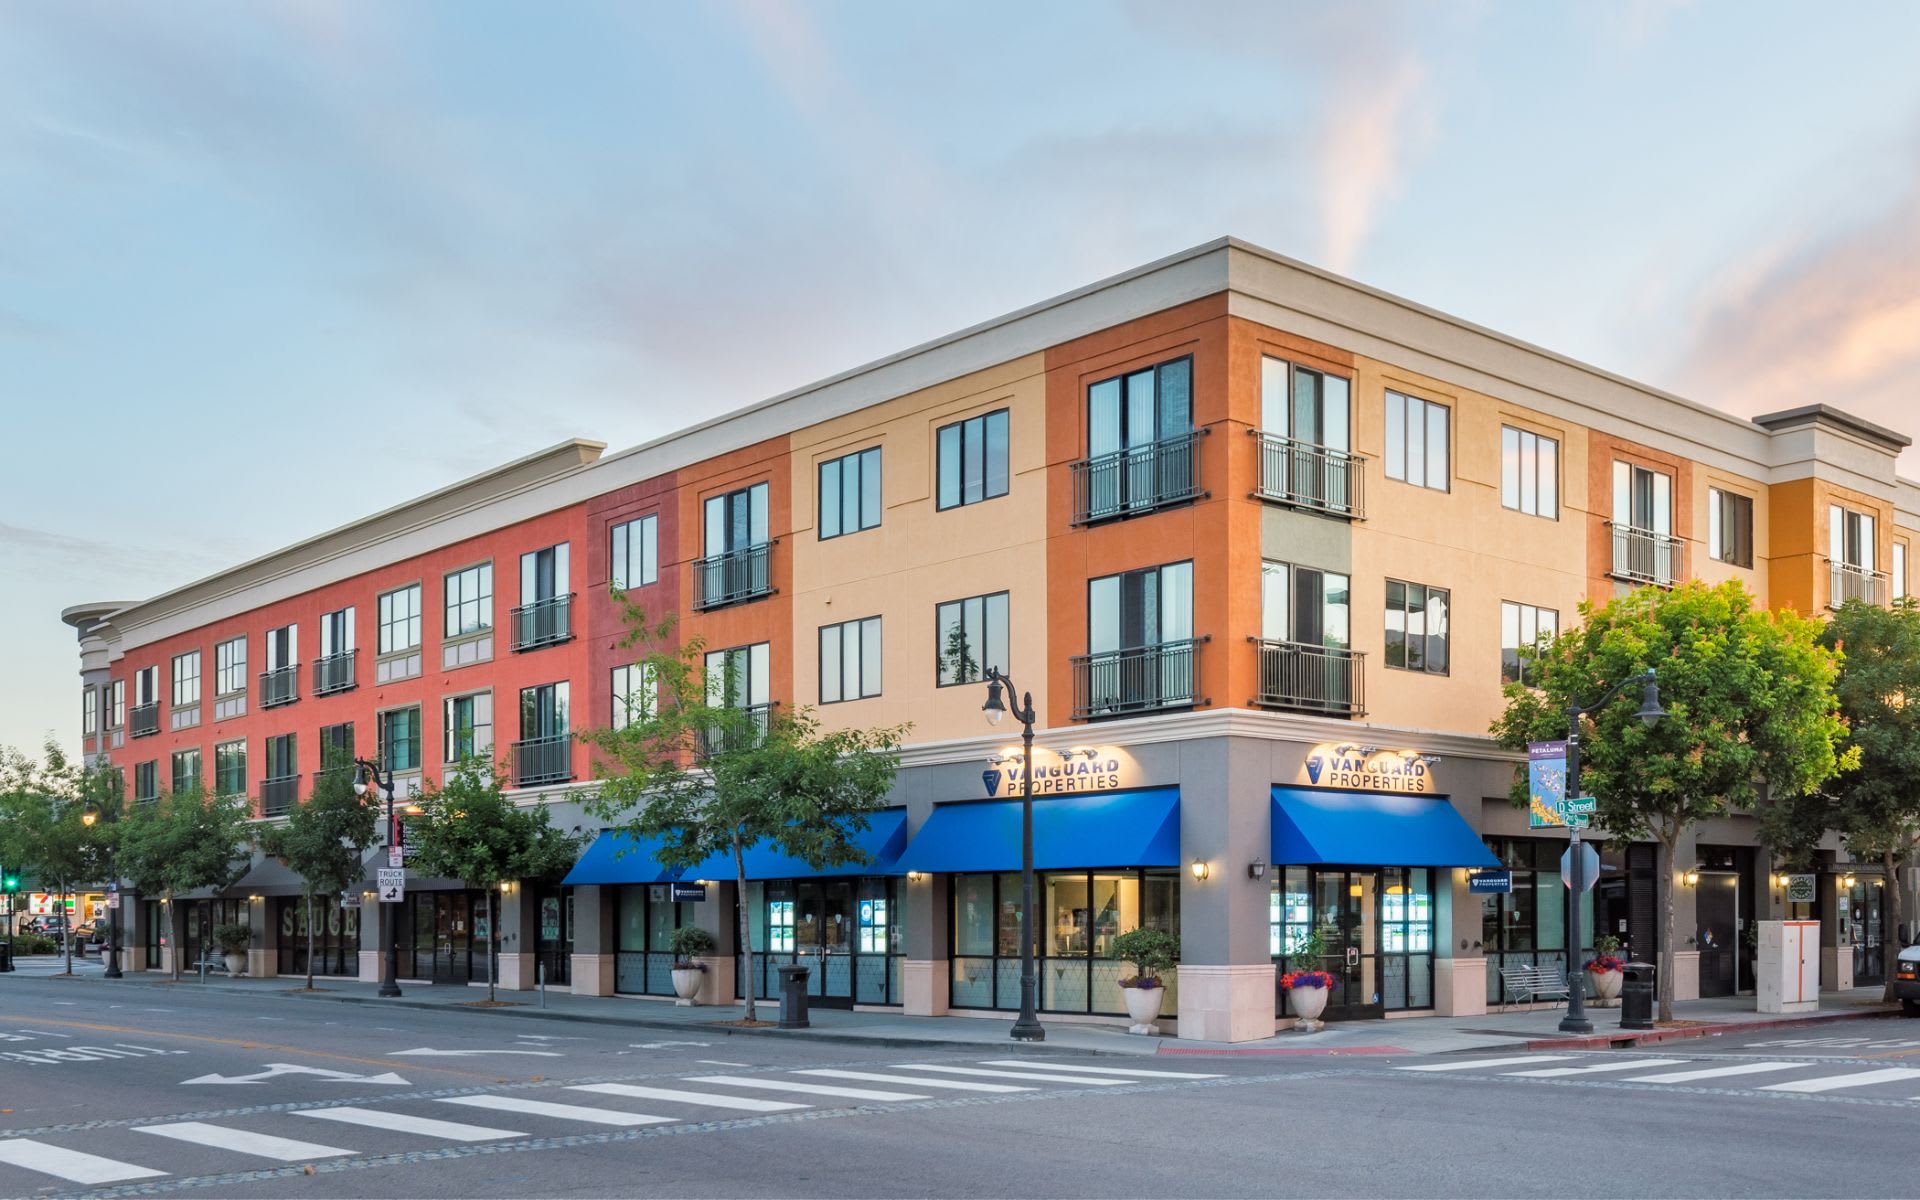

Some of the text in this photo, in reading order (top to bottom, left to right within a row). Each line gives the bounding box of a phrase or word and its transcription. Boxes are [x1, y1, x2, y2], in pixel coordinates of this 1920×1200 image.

[1329, 757, 1425, 777] VANGUARD
[1330, 772, 1425, 792] PROPERTIES
[1559, 800, 1593, 812] D Street
[380, 878, 402, 886] ROUTE
[34, 895, 49, 913] 7
